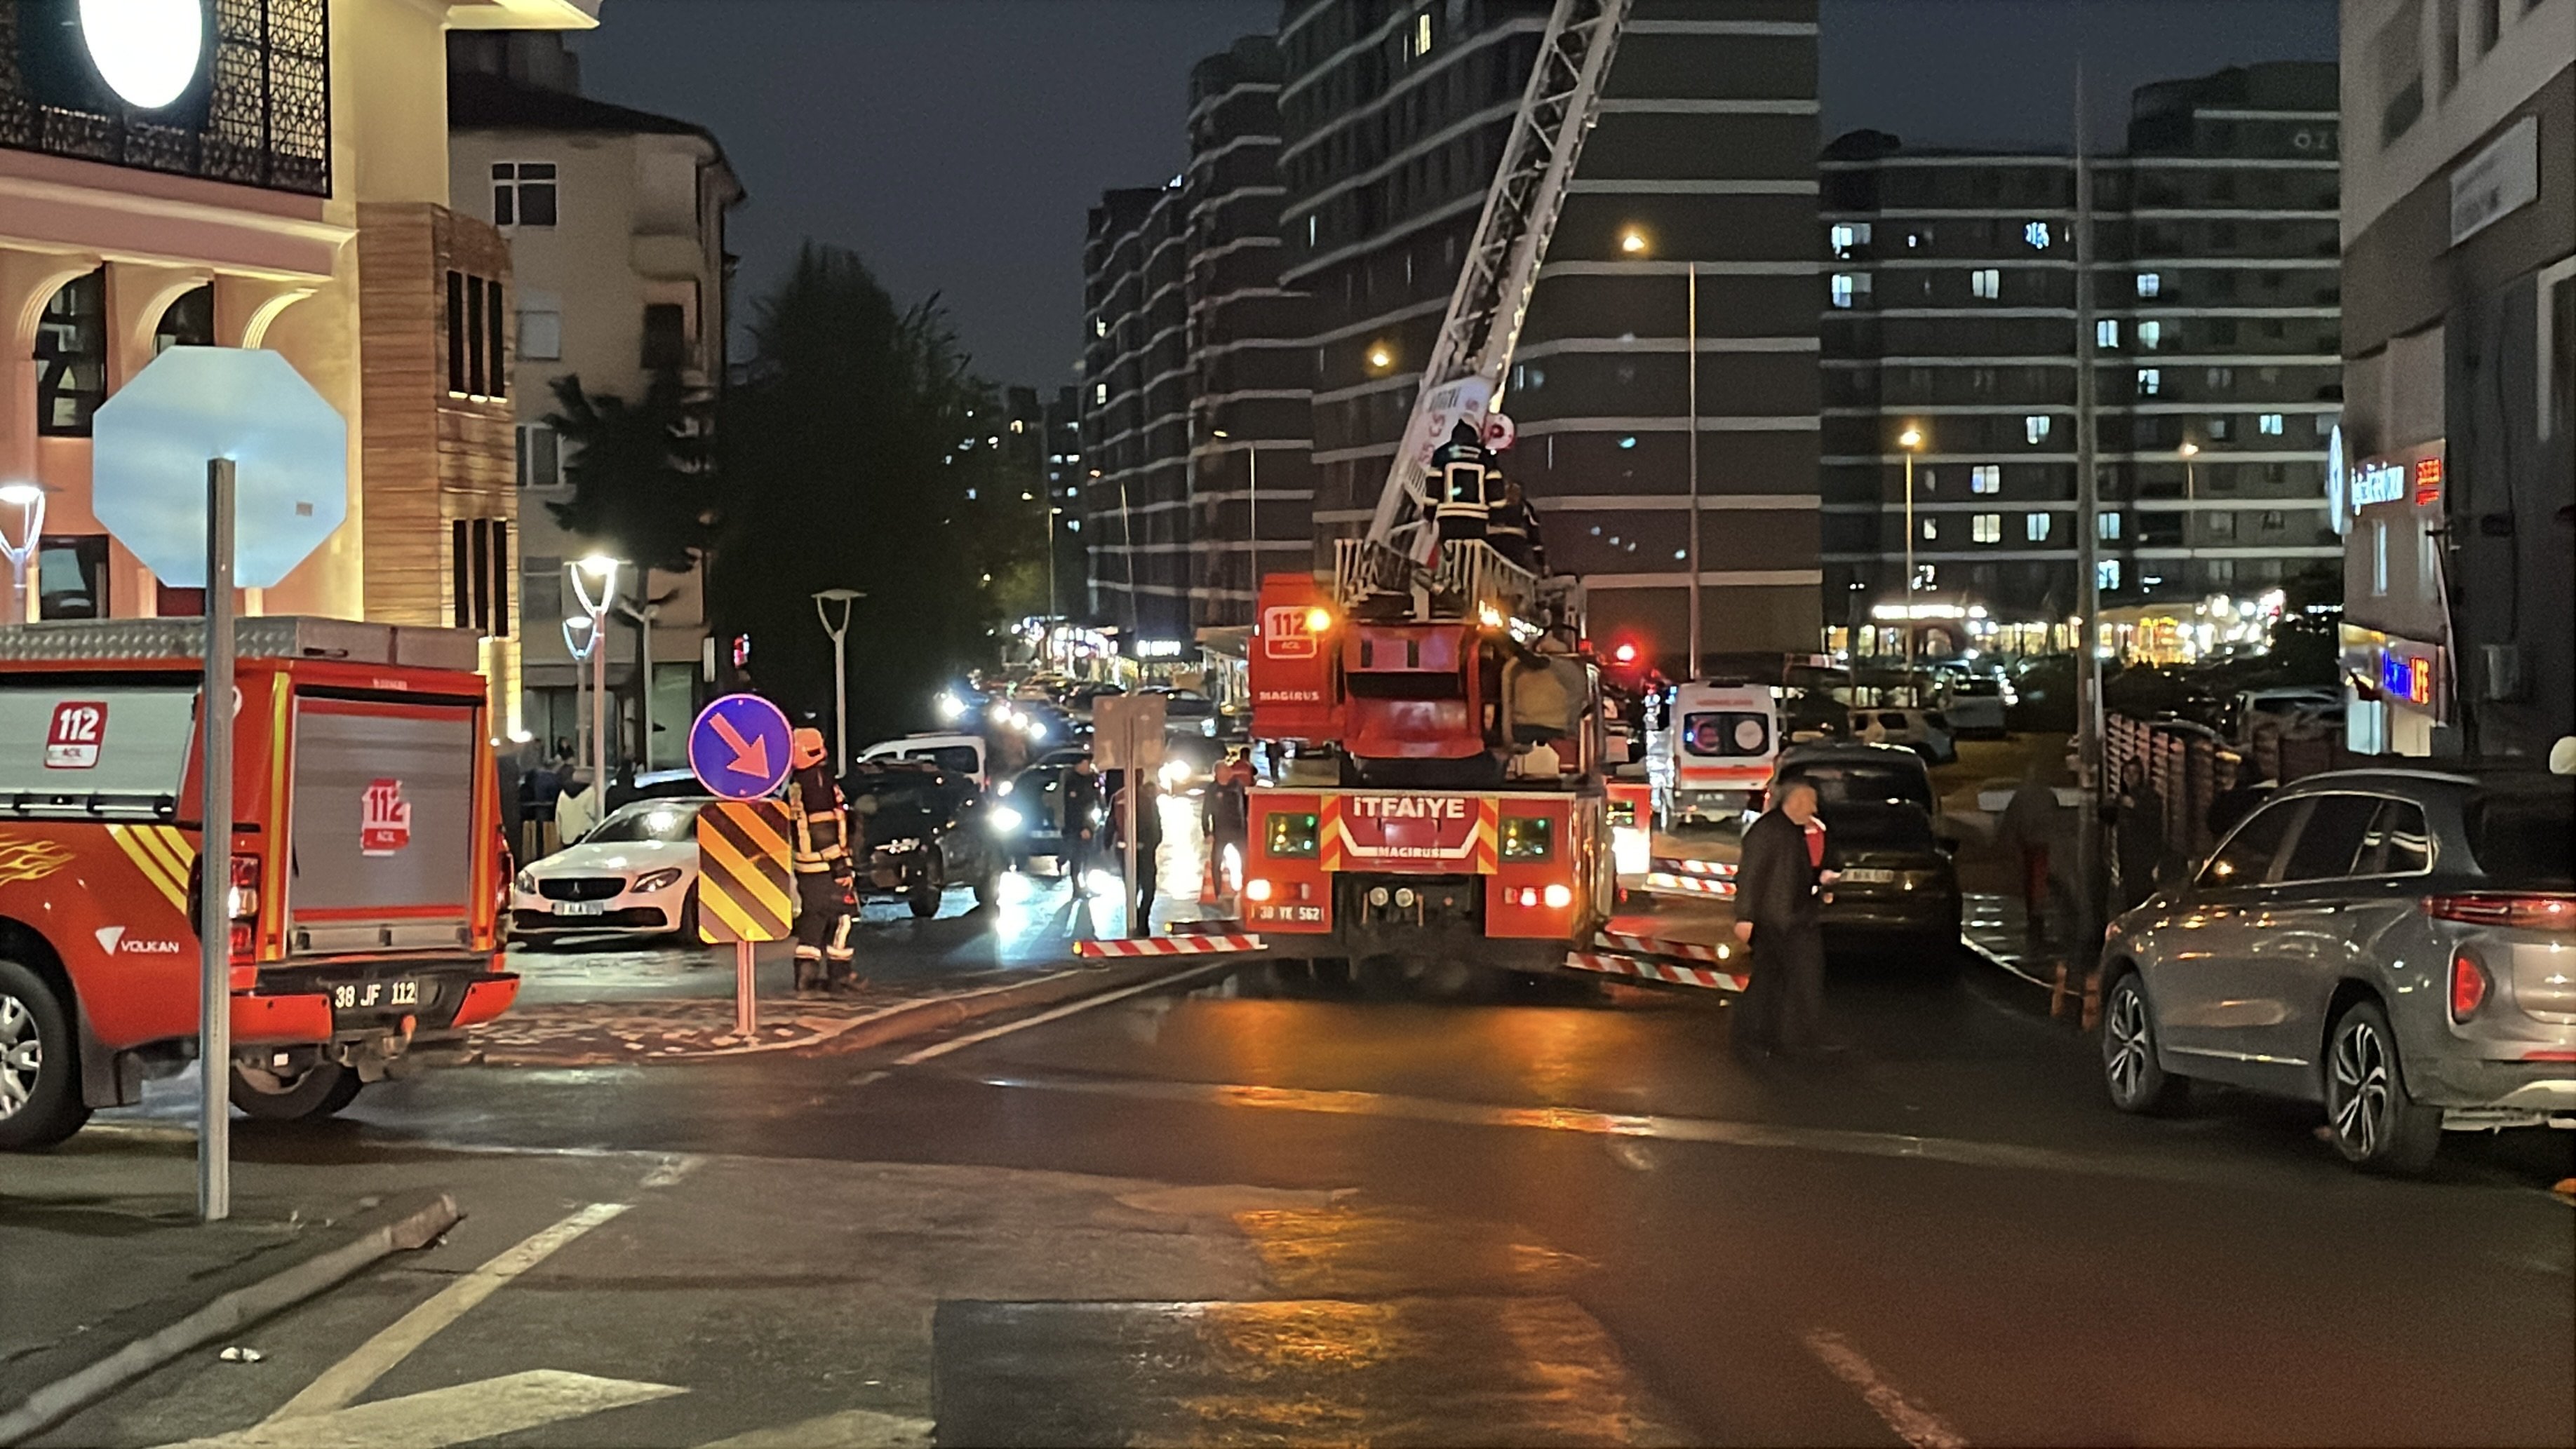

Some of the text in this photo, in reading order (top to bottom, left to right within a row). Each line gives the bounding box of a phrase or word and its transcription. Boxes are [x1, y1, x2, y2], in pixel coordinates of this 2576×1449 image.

[1273, 613, 1309, 635] 112
[1259, 691, 1320, 701] MAGIRUS
[59, 707, 99, 741] 112
[370, 789, 403, 822] 112
[1378, 847, 1440, 858] MAGIRUS
[121, 941, 180, 953] VOLKAN
[335, 982, 415, 1008] 38 JF 112
